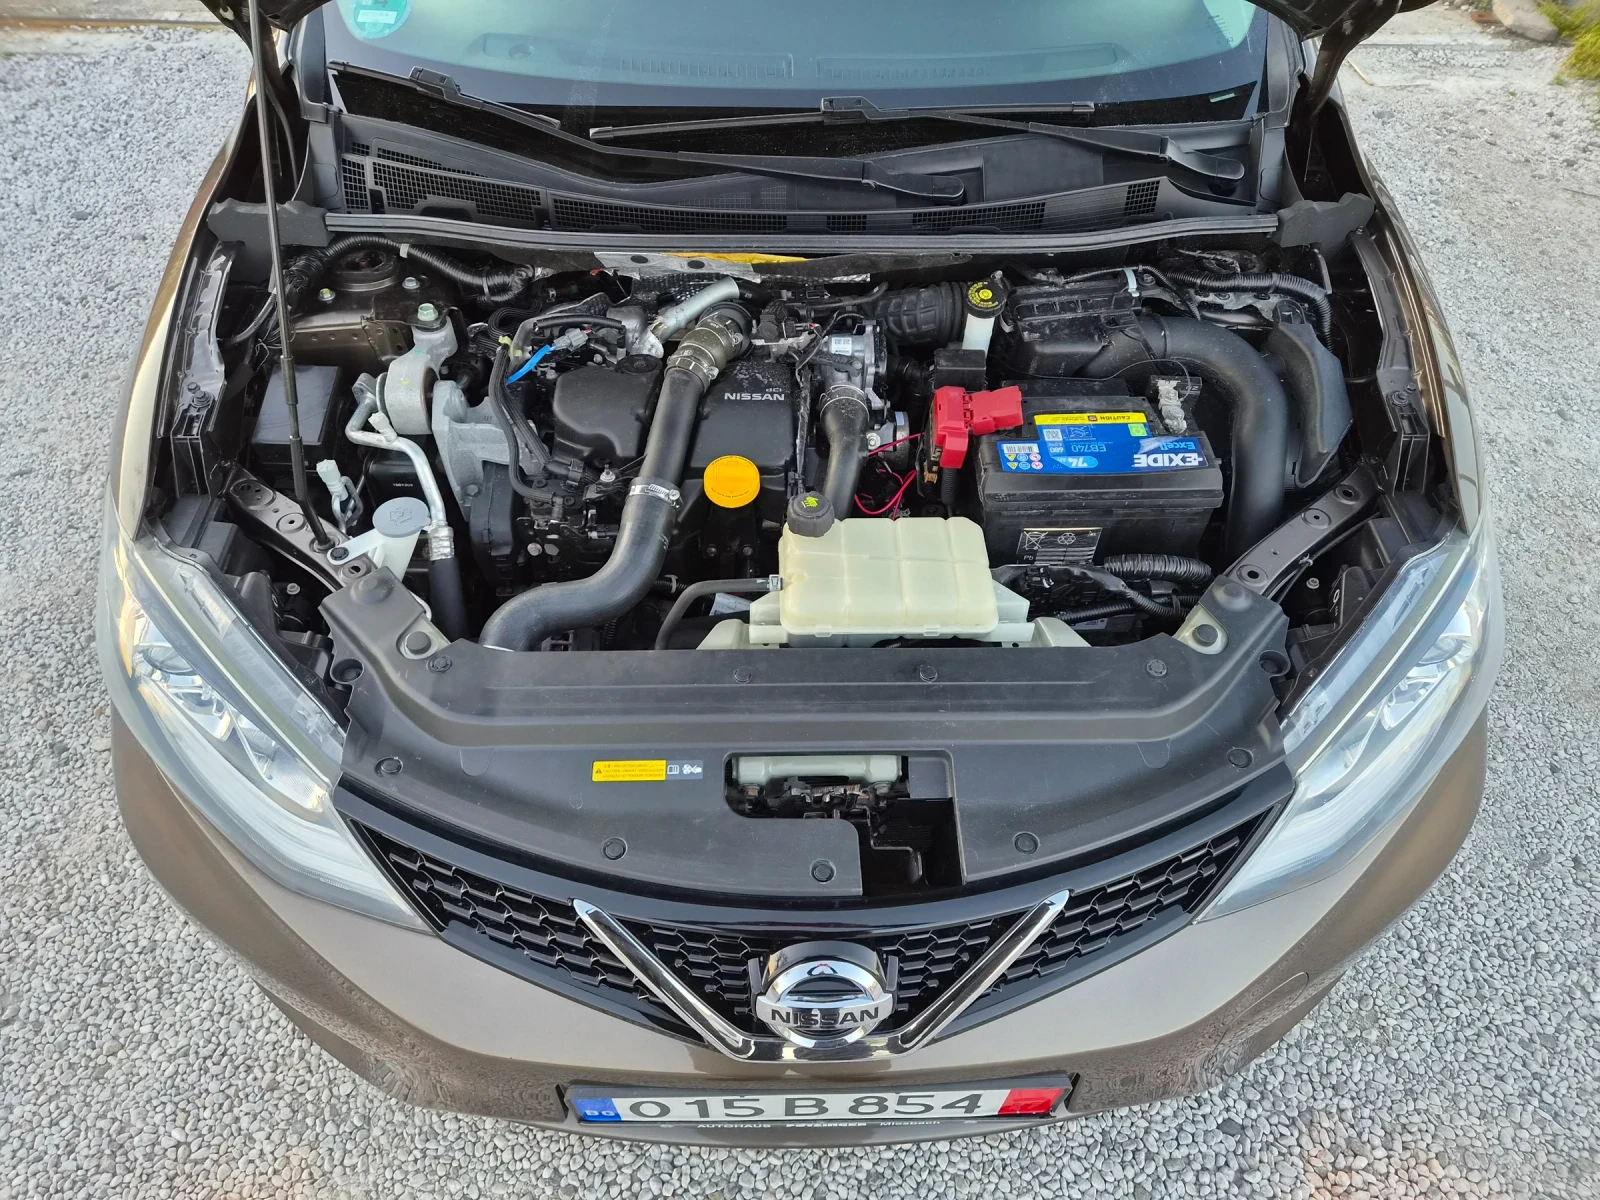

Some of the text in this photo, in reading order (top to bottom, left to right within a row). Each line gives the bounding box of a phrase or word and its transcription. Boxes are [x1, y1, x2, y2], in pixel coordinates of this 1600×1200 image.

[724, 392, 785, 401] NISSAN
[1071, 444, 1107, 453] EB740
[1160, 441, 1196, 451] Excell
[1067, 456, 1089, 467] 74
[1133, 452, 1203, 468] EXIDE
[771, 1007, 879, 1026] NISSAN
[784, 1097, 829, 1117] B
[849, 1094, 983, 1116] 854
